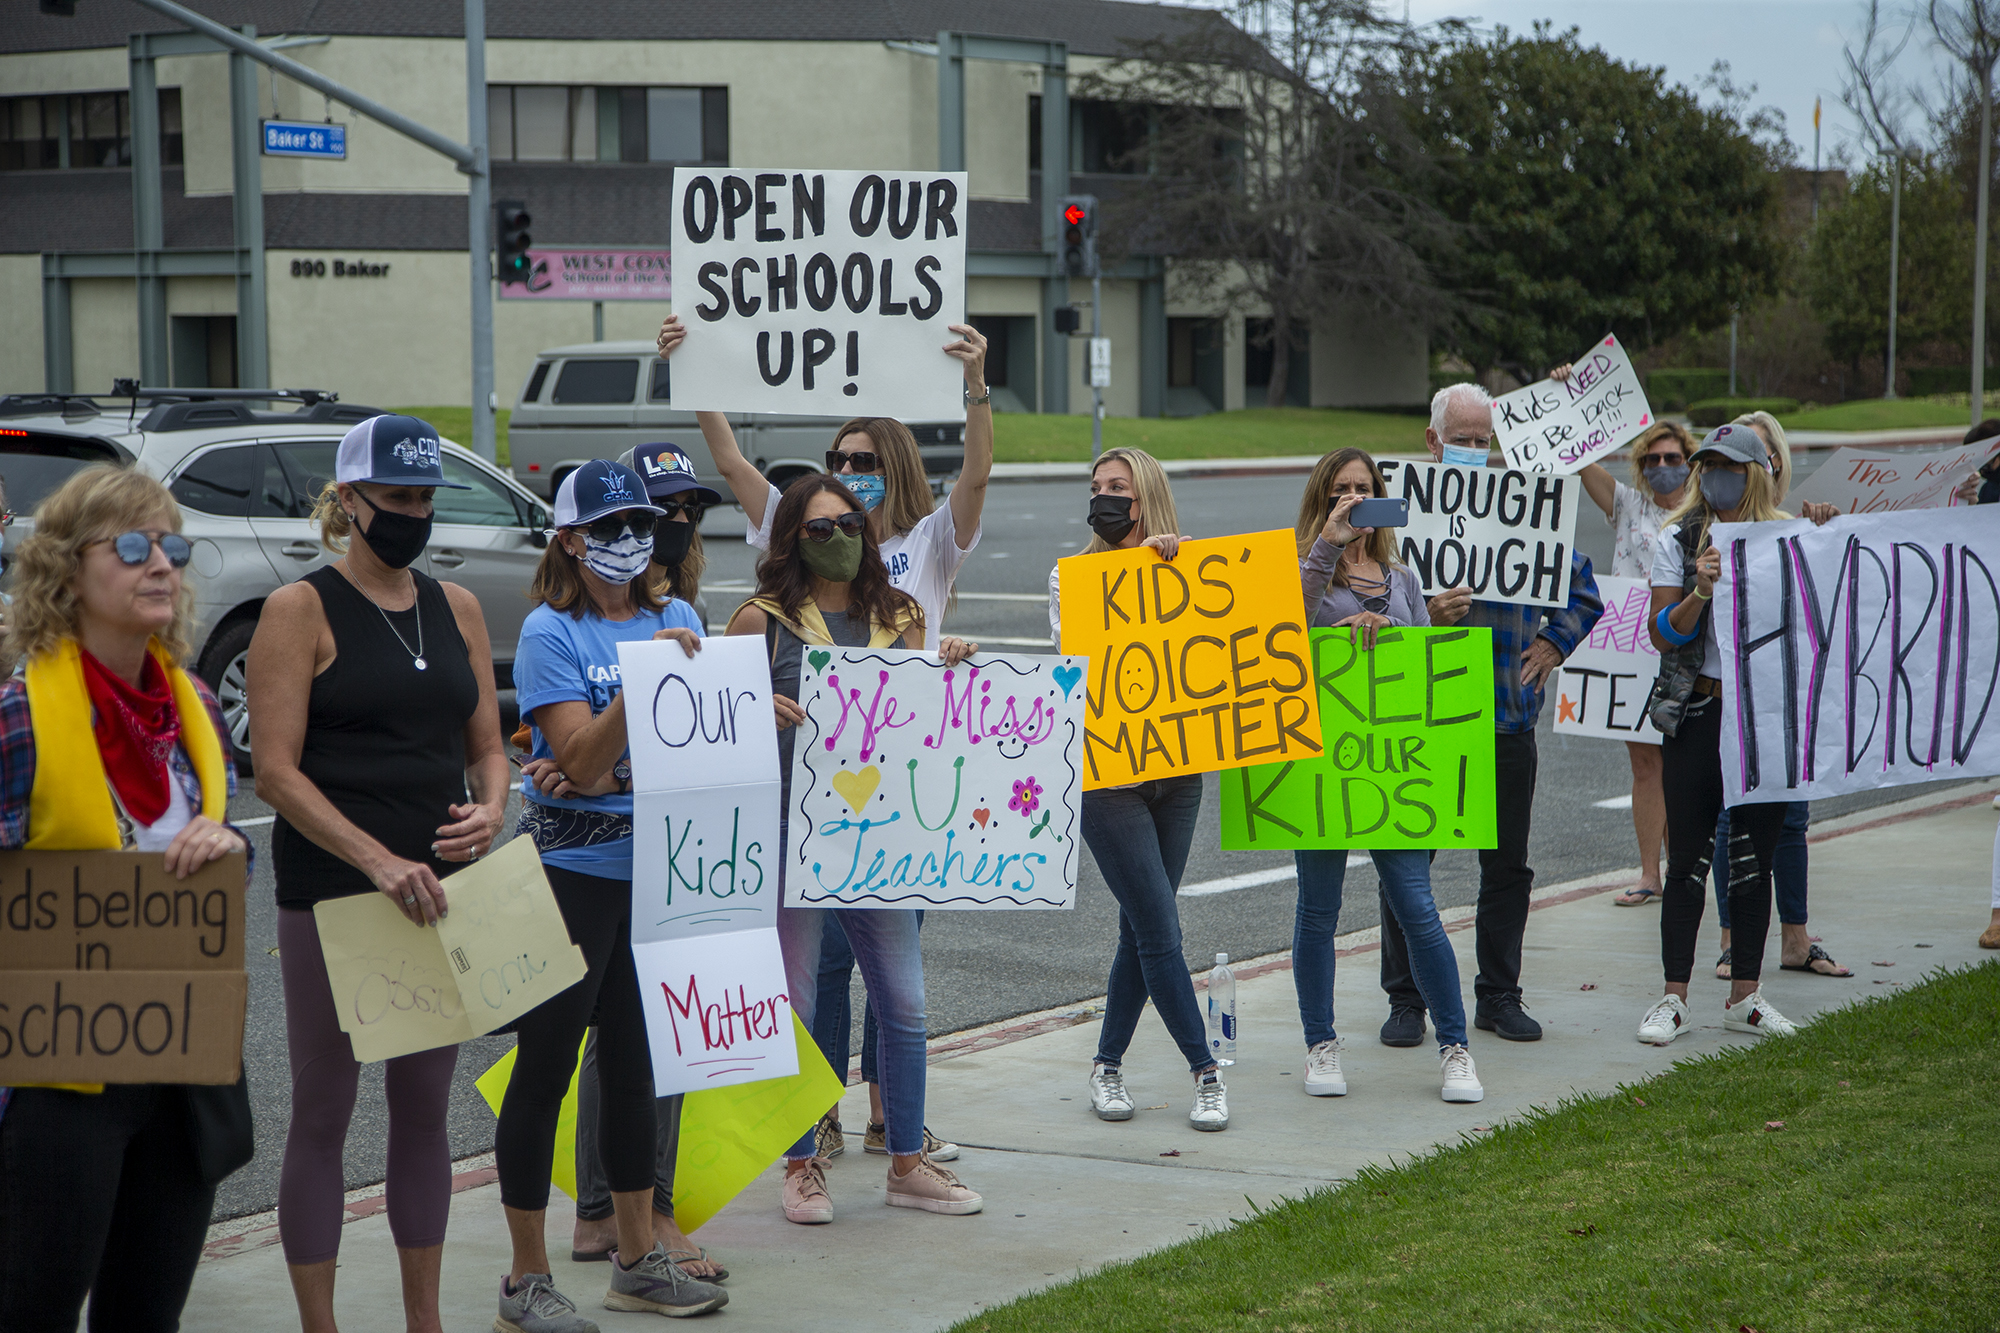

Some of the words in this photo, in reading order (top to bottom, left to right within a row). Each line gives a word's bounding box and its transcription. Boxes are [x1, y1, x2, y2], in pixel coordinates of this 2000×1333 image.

[267, 129, 307, 148] Baker
[309, 131, 324, 149] St
[683, 173, 825, 243] OPEN
[849, 174, 958, 241] OUR
[290, 258, 326, 278] 890
[332, 258, 391, 278] Baker
[562, 254, 615, 270] WEST
[562, 272, 609, 284] School
[614, 272, 629, 283] of
[633, 272, 656, 284] the
[695, 252, 943, 322] SCHOOLS
[757, 328, 859, 396] UP!
[1500, 390, 1560, 432] Kids
[1564, 354, 1612, 400] NEED
[1542, 425, 1579, 450] Be
[1581, 383, 1633, 425] back
[1713, 426, 1733, 442] P
[603, 491, 633, 502] CDM
[1848, 459, 1901, 487] The
[1450, 514, 1466, 538] IS
[1102, 547, 1251, 631] KIDS'
[1086, 622, 1308, 720] VOICES
[1730, 534, 2000, 797] HYBRID
[653, 673, 756, 748] Our
[825, 670, 916, 763] We
[924, 667, 1055, 749] Miss
[1083, 695, 1323, 781] MATTER
[1333, 731, 1431, 773] OUR
[907, 756, 965, 831] U
[1241, 755, 1467, 842] KIDS!
[665, 807, 763, 906] Kids
[812, 811, 1046, 893] Teachers
[0, 867, 57, 931] ds
[73, 865, 226, 958] belong
[75, 931, 110, 971] in
[661, 974, 788, 1057] Matter
